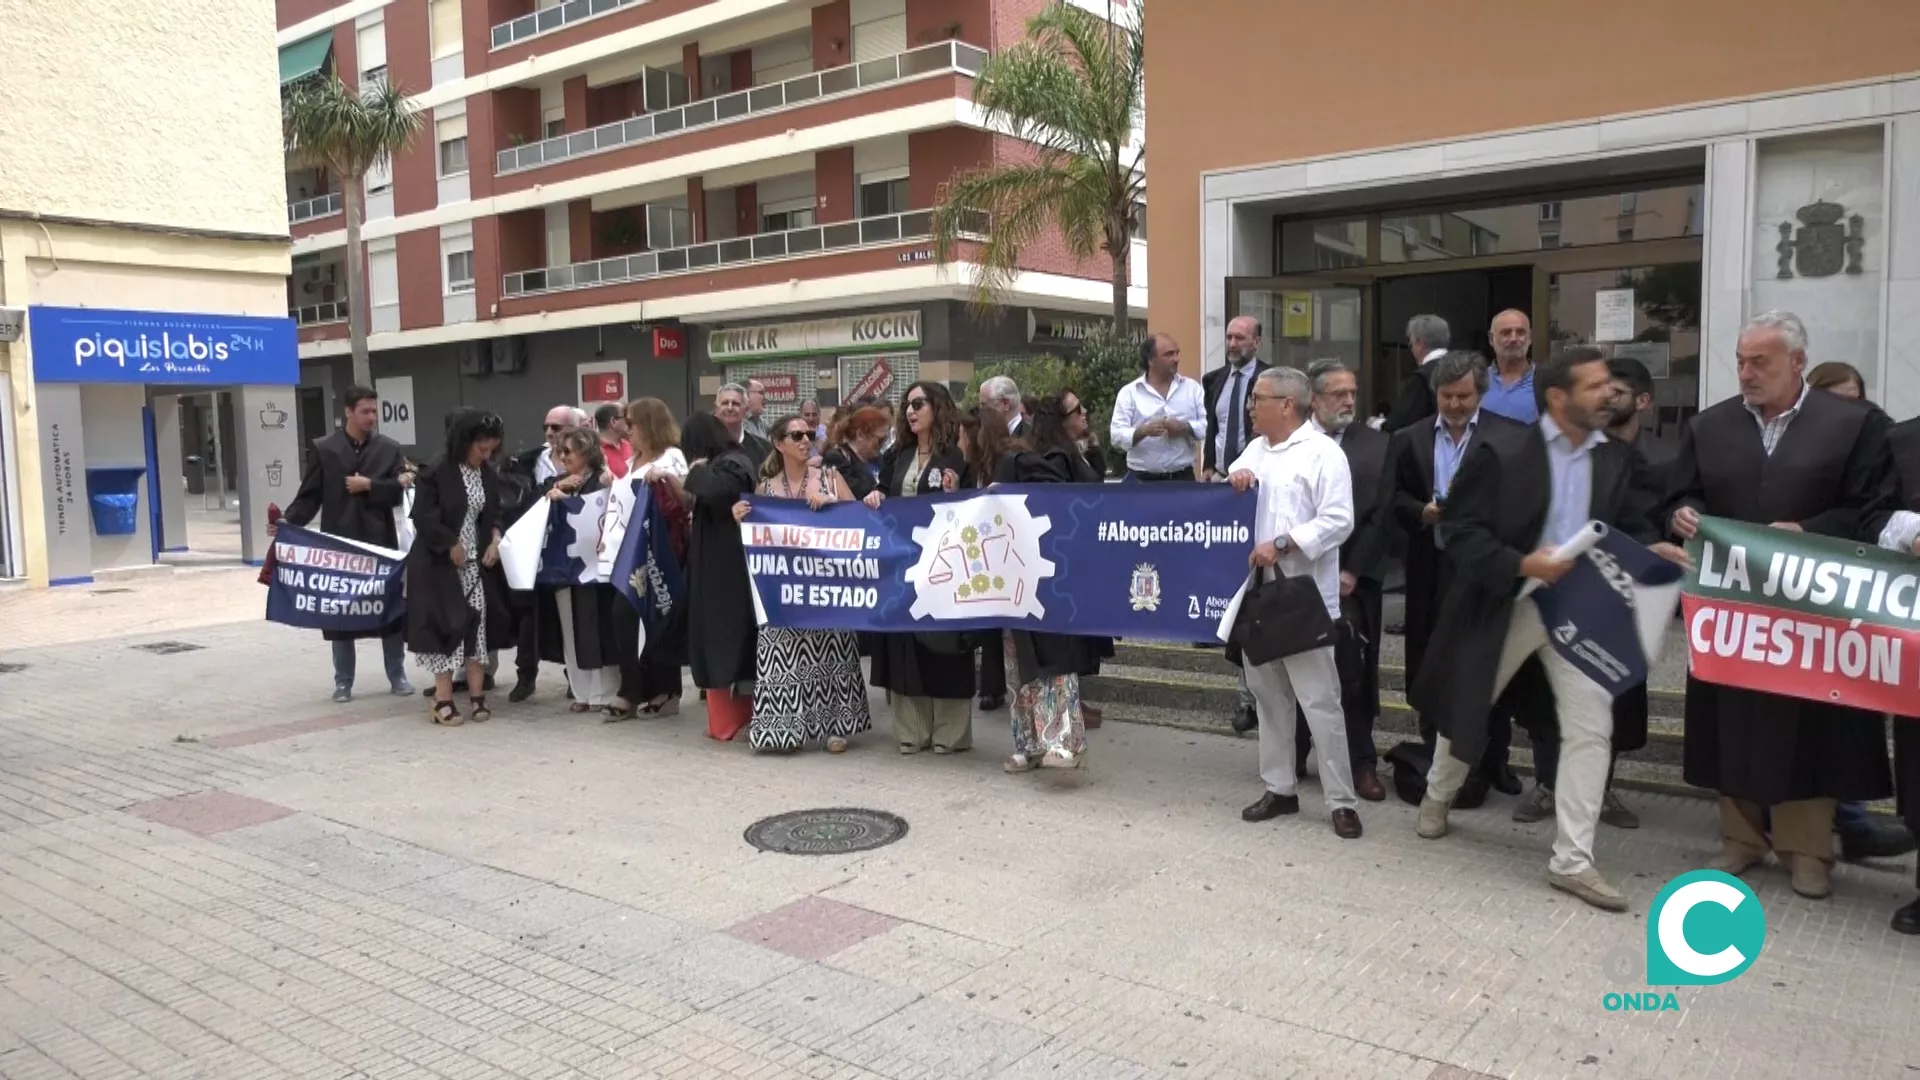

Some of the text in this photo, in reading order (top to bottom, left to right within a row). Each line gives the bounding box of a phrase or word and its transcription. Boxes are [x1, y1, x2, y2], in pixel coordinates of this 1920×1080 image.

[728, 314, 915, 352] MILAR KOCIN
[75, 331, 229, 367] piquislabis
[765, 391, 795, 401] RASLADO
[873, 373, 894, 397] SLADO
[382, 400, 409, 422] Dia
[63, 451, 72, 488] HORAS
[57, 496, 66, 535] TIENDA
[752, 526, 881, 549] LA JUSTICIA ES
[1098, 520, 1249, 549] #Abogacía28junio
[277, 545, 296, 562] LA
[304, 547, 375, 573] JUSTICIA
[750, 553, 880, 579] UNA CUESTIÓN
[1699, 540, 1751, 591] LA
[278, 566, 386, 596] UNA CUESTIÓN
[295, 593, 384, 616] DE ESTADO
[781, 583, 878, 609] DE ESTADO
[1205, 596, 1231, 611] Abog
[1204, 608, 1225, 620] Espa
[1691, 606, 1902, 685] CUESTIÓN
